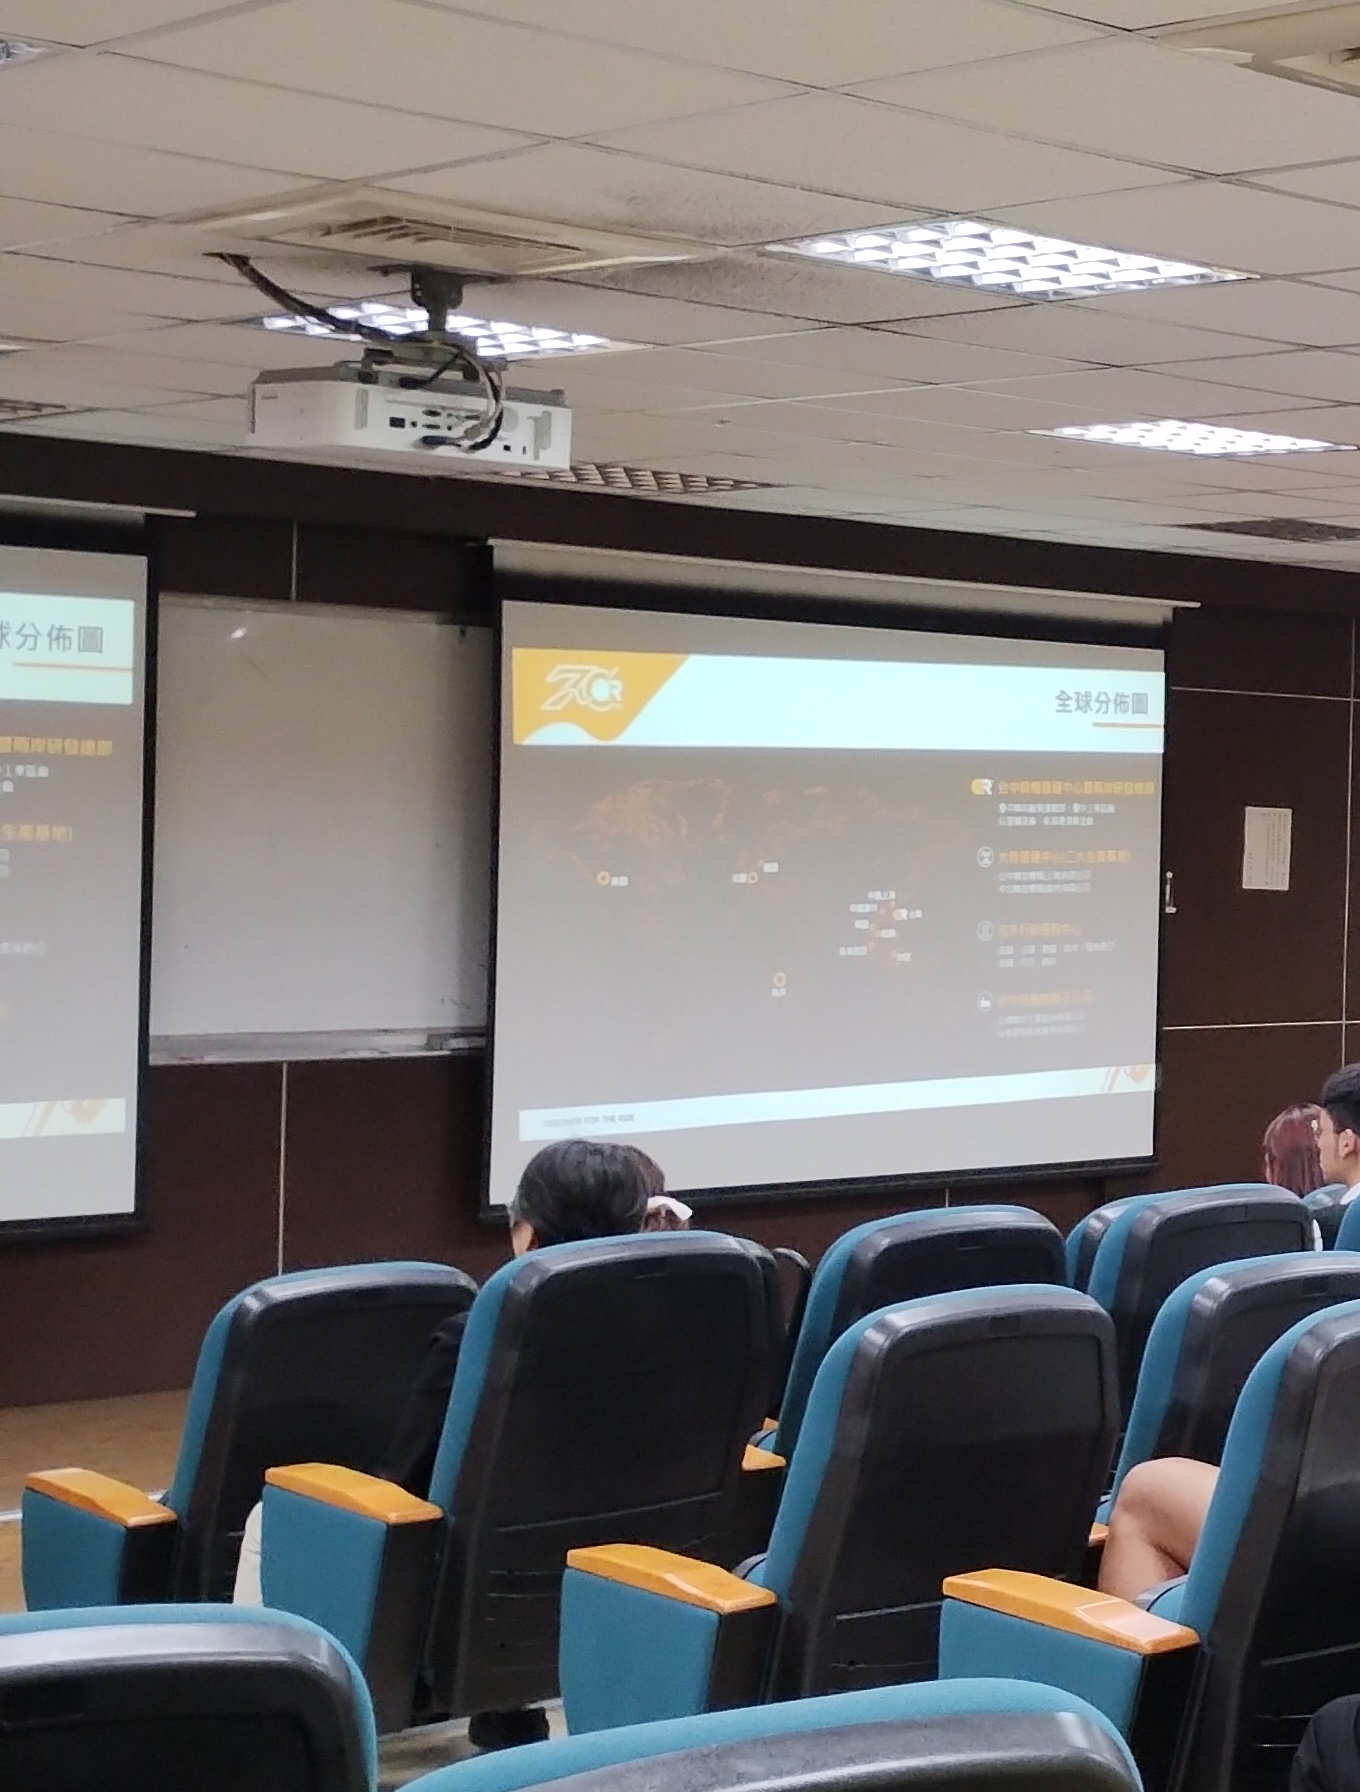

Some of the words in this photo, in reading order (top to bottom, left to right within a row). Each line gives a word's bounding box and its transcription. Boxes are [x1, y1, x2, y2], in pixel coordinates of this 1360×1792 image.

[1055, 690, 1148, 715] 全球分佈圖
